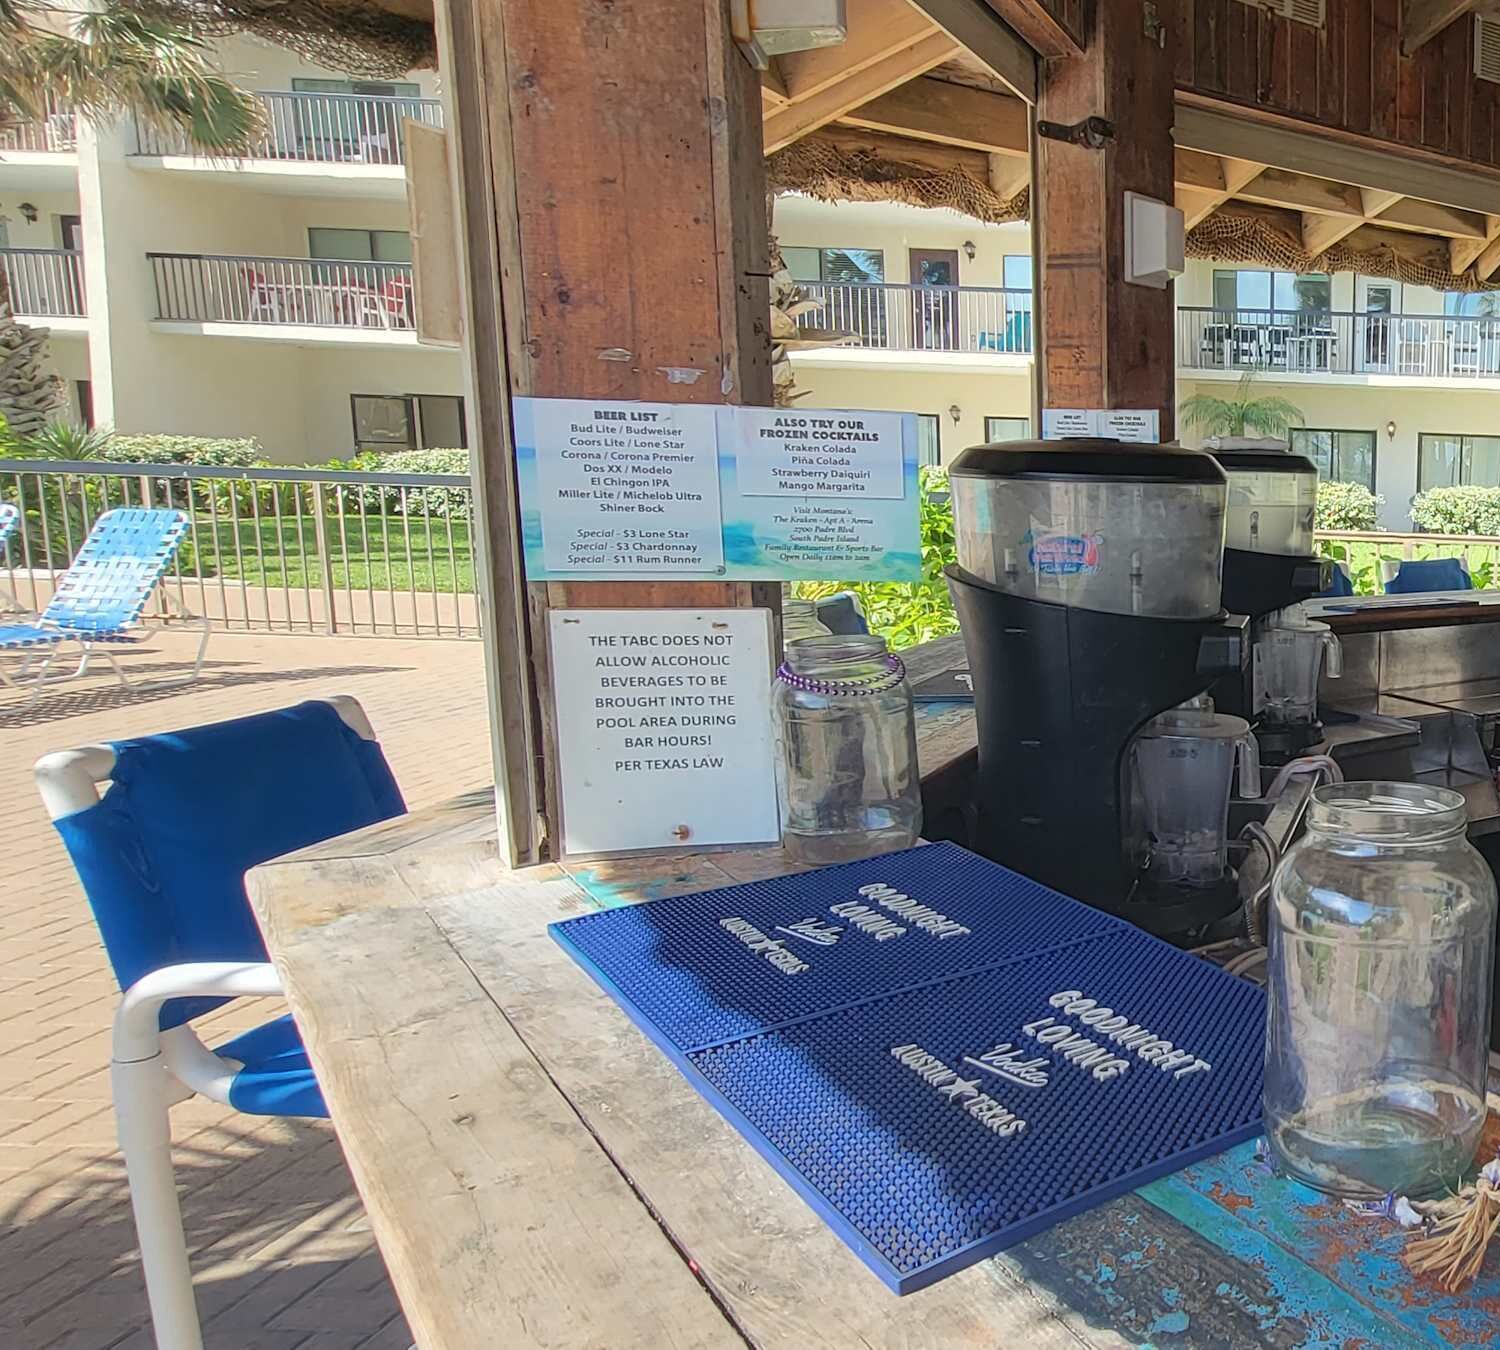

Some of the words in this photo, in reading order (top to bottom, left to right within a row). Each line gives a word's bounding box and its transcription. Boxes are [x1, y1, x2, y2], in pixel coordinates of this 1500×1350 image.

[594, 410, 627, 421] BEER
[631, 412, 658, 422] LIST
[571, 424, 592, 433] Bud
[596, 424, 616, 434] Lite
[626, 426, 682, 436] Budweiser
[774, 418, 807, 427] ALSO
[810, 419, 834, 429] TRY
[838, 420, 864, 430] OUR
[760, 429, 808, 439] FROZEN
[812, 431, 879, 441] COCKTAILS
[570, 437, 601, 446] Coors
[604, 438, 625, 447] Lite
[634, 439, 661, 448] Lone
[663, 440, 684, 449] Star
[784, 443, 820, 453] Kraken
[822, 445, 856, 453] Colada
[561, 450, 601, 459] Corona
[611, 452, 650, 461] Corona
[653, 453, 694, 462] Premier
[792, 456, 813, 465] Piña
[817, 456, 850, 465] Colada
[584, 464, 604, 473] Dos
[607, 465, 622, 473] XX
[632, 465, 672, 475] Modelo
[772, 468, 828, 479] Strawberry
[831, 470, 870, 480] Daiquiri
[591, 477, 600, 485] El
[604, 478, 649, 488] Chingon
[653, 479, 670, 487] IPA
[779, 481, 814, 491] Mango
[817, 482, 865, 493] Margarita
[559, 490, 590, 498] Miller
[593, 491, 614, 499] Lite
[624, 491, 673, 500] Michelob
[676, 492, 701, 501] Ultra
[600, 503, 635, 512] Shiner
[638, 504, 664, 513] Bock
[773, 515, 788, 523] The
[577, 529, 614, 539] Special
[624, 529, 636, 538] $3
[639, 530, 665, 538] Lone
[668, 530, 689, 538] Star
[570, 541, 608, 552] Special
[617, 542, 629, 551] $3
[633, 542, 697, 553] Chardonnay
[765, 544, 791, 552] Family
[568, 555, 605, 565] Special
[614, 555, 633, 564] $11
[637, 556, 661, 564] Rum
[663, 556, 701, 564] Runner
[780, 553, 799, 561] Open
[802, 553, 822, 562] Daily
[589, 635, 617, 646] THE
[620, 635, 659, 646] TABC
[663, 635, 700, 646] DOES
[704, 635, 734, 646] NOT
[595, 656, 647, 667] ALLOW
[651, 655, 731, 667] ALCOHOLIC
[601, 676, 684, 687] BEVERAGES
[688, 676, 706, 686] TO
[711, 675, 728, 685] BE
[595, 696, 667, 708] BROUGHT
[671, 696, 705, 707] INTO
[708, 695, 735, 706] THE
[597, 717, 636, 728] POOL
[640, 716, 677, 728] AREA
[682, 715, 736, 726] DURING
[625, 737, 654, 748] BAR
[658, 735, 712, 747] HOURS!
[615, 760, 641, 771] PER
[645, 758, 689, 770] TEXAS
[693, 757, 724, 769] LAW
[857, 882, 971, 940] GOODNIGHT
[829, 900, 907, 942] LOVING
[776, 916, 845, 947] Vodka
[718, 916, 769, 954] AUSTIN
[764, 945, 810, 975] TEXAS
[1048, 989, 1212, 1080] GOODNIGHT
[1021, 1017, 1131, 1082] LOVING
[963, 1043, 1050, 1087] Vodka
[890, 1044, 959, 1091] AUSTIN
[963, 1093, 1030, 1137] TEXAS
